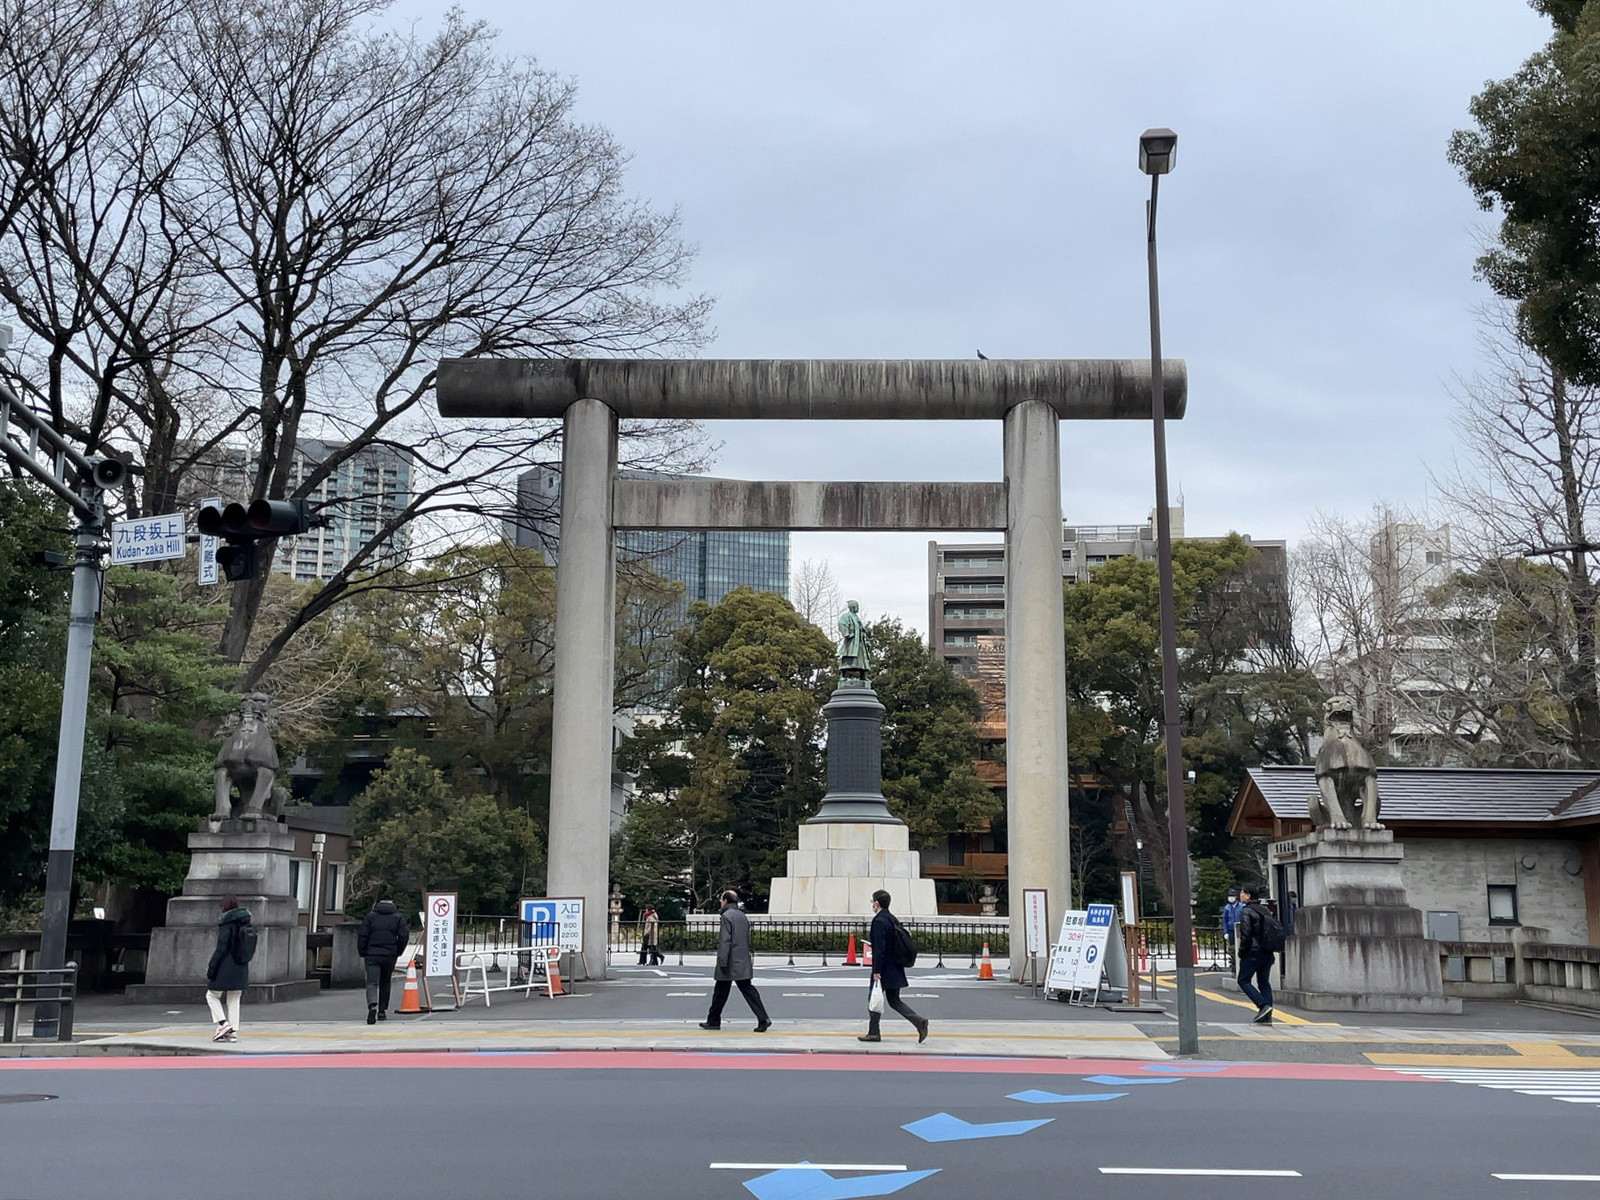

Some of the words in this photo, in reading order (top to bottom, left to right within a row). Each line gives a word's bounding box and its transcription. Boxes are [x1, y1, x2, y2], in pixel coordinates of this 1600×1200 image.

[118, 521, 178, 544] 九段坂上
[116, 544, 164, 559] Kudan-zaka
[166, 540, 180, 553] Hill
[561, 903, 580, 914] 入口
[1066, 916, 1084, 926] 駐車場
